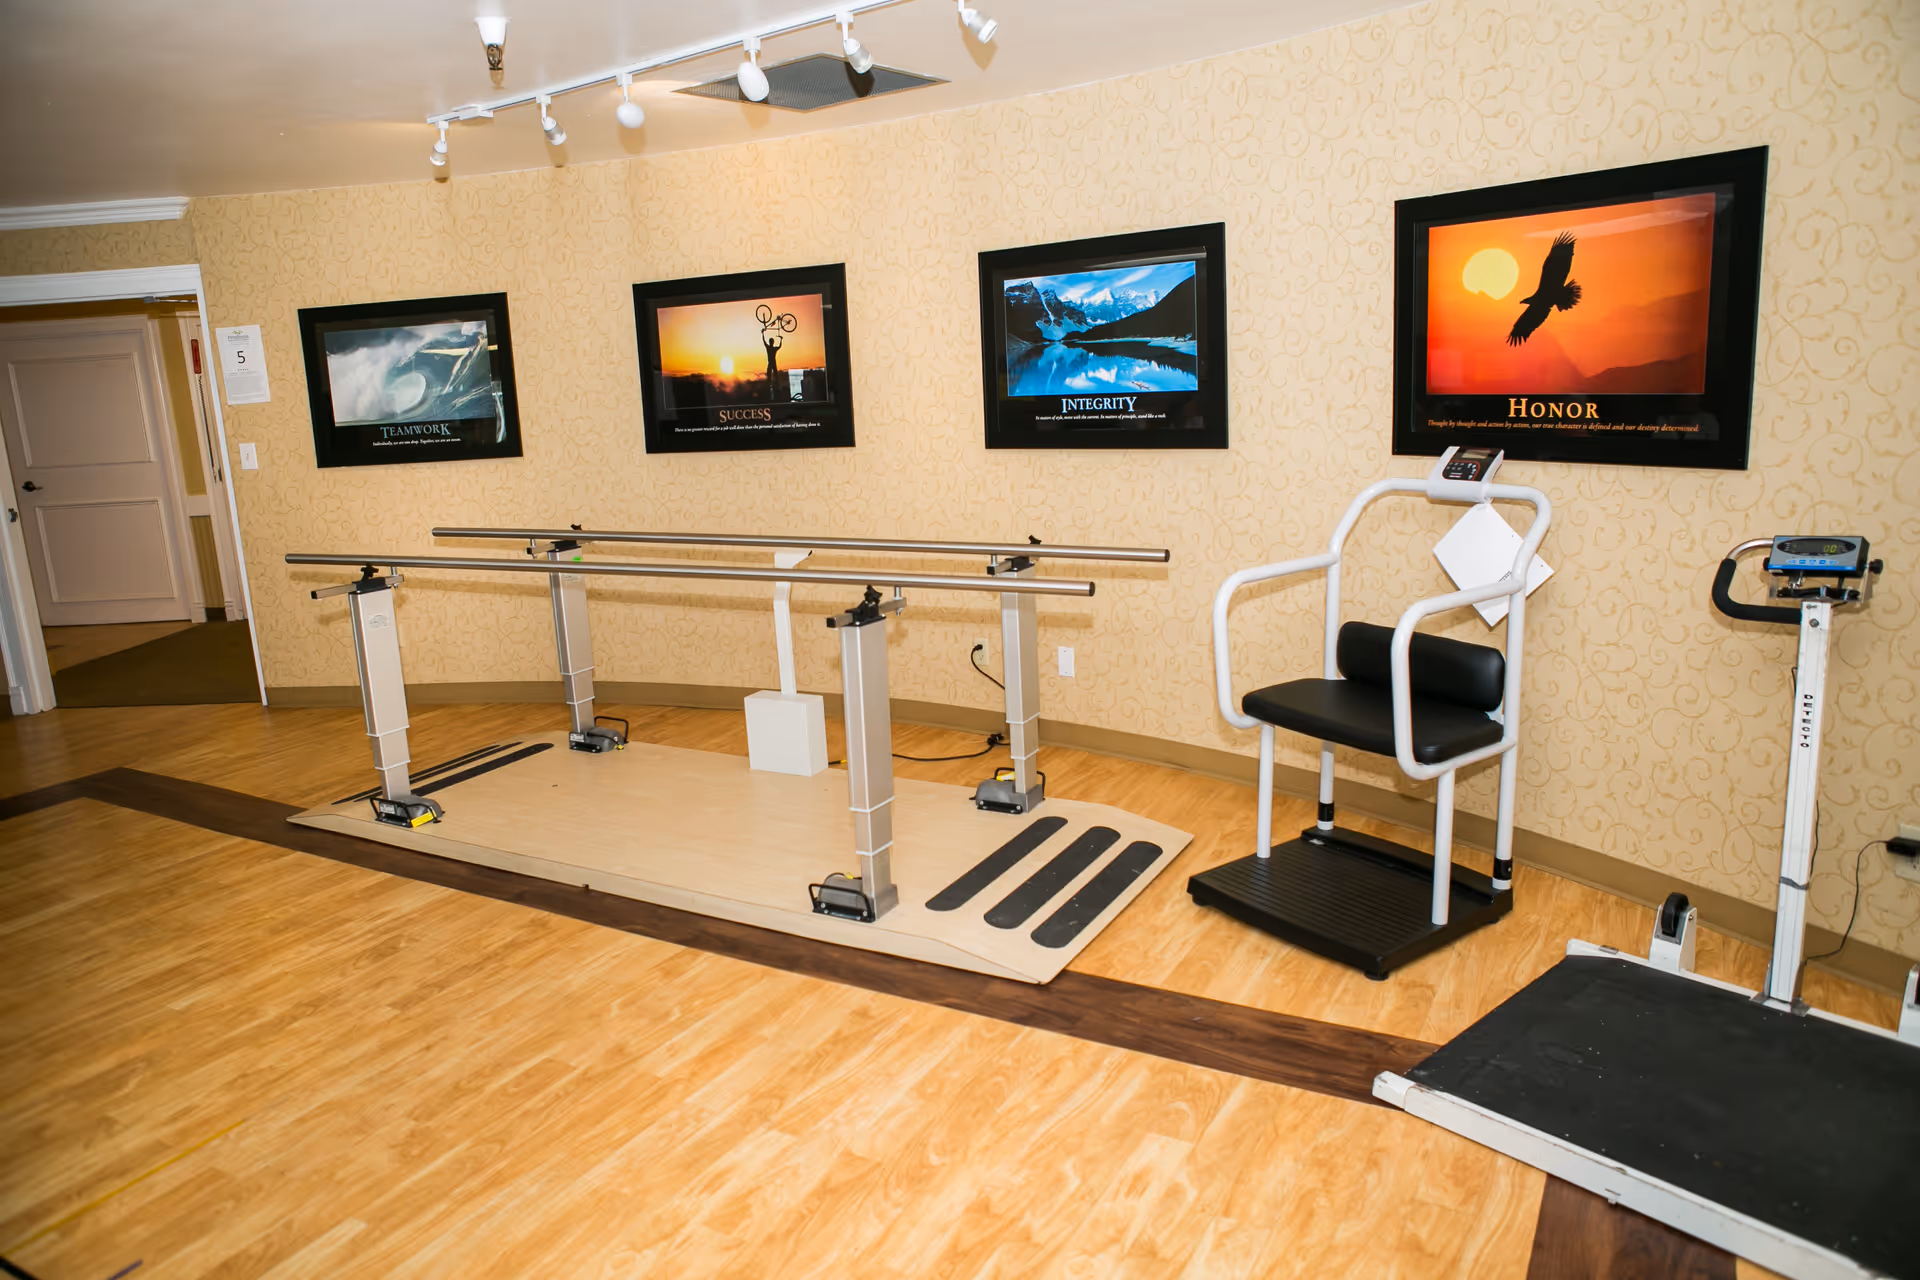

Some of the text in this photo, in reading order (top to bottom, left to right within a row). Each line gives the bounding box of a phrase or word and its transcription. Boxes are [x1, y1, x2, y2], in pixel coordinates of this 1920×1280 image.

[237, 350, 246, 364] 5
[1061, 397, 1137, 413] INTEGRITY
[1508, 398, 1599, 418] HONOR
[719, 408, 771, 423] SUCCESS
[380, 423, 451, 439] TEAMWORK
[1427, 419, 1448, 428] Thought
[1448, 419, 1456, 429] by
[1456, 419, 1477, 429] thought
[1504, 420, 1512, 430] by
[1555, 421, 1582, 429] character
[1588, 422, 1612, 431] defined
[1611, 422, 1625, 430] and
[1636, 423, 1660, 433] destiny
[1800, 693, 1814, 748] DETECTO
